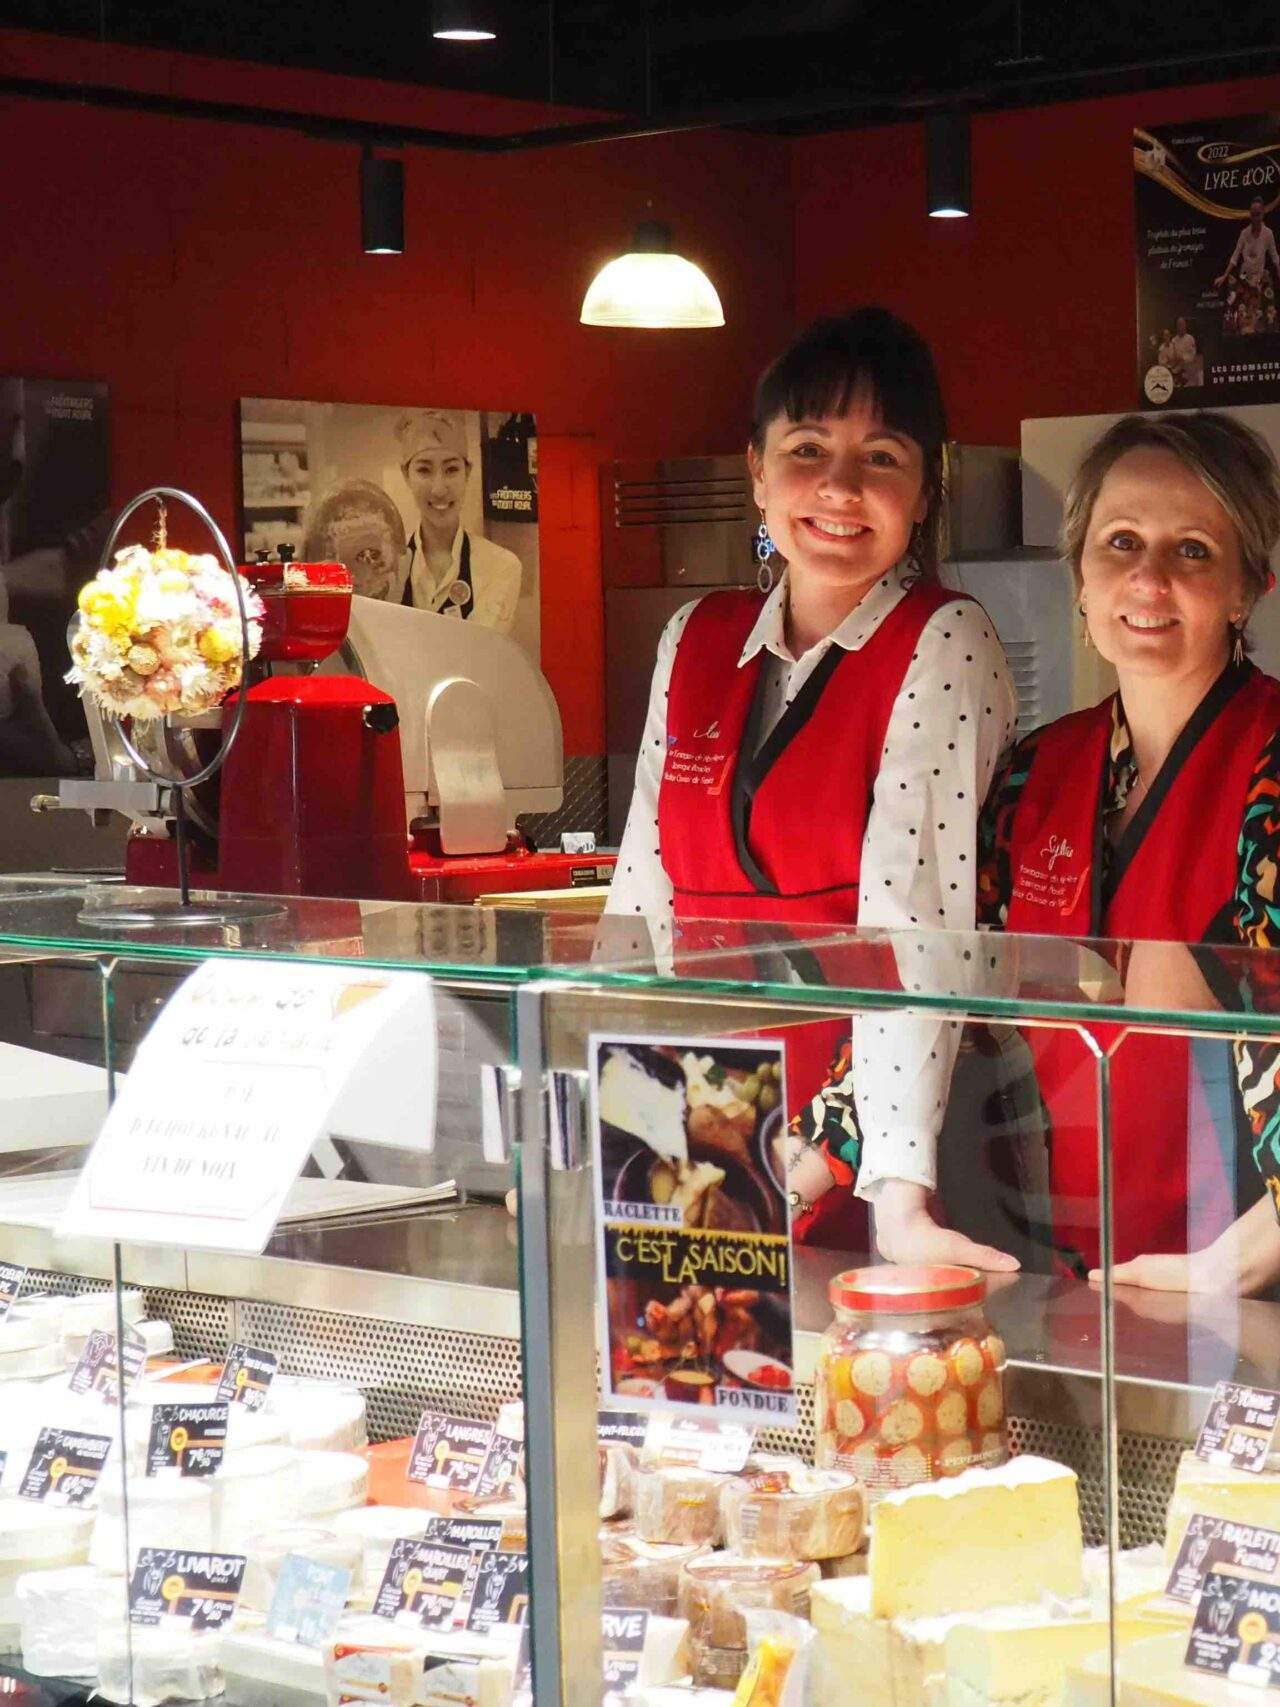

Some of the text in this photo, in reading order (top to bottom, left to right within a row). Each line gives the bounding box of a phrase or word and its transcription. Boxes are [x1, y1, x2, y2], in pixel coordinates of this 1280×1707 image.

[1204, 165, 1276, 191] LYRE d'OR
[1228, 374, 1255, 383] MONT
[603, 1202, 682, 1222] RACLETTE
[616, 1238, 787, 1287] C'EST LA SAISON!
[717, 1388, 789, 1414] FONDUE
[180, 1407, 229, 1424] CHAOURCE
[445, 1423, 492, 1446] LANGRES
[176, 1554, 247, 1580] LIVAROT
[602, 1613, 643, 1638] RVE
